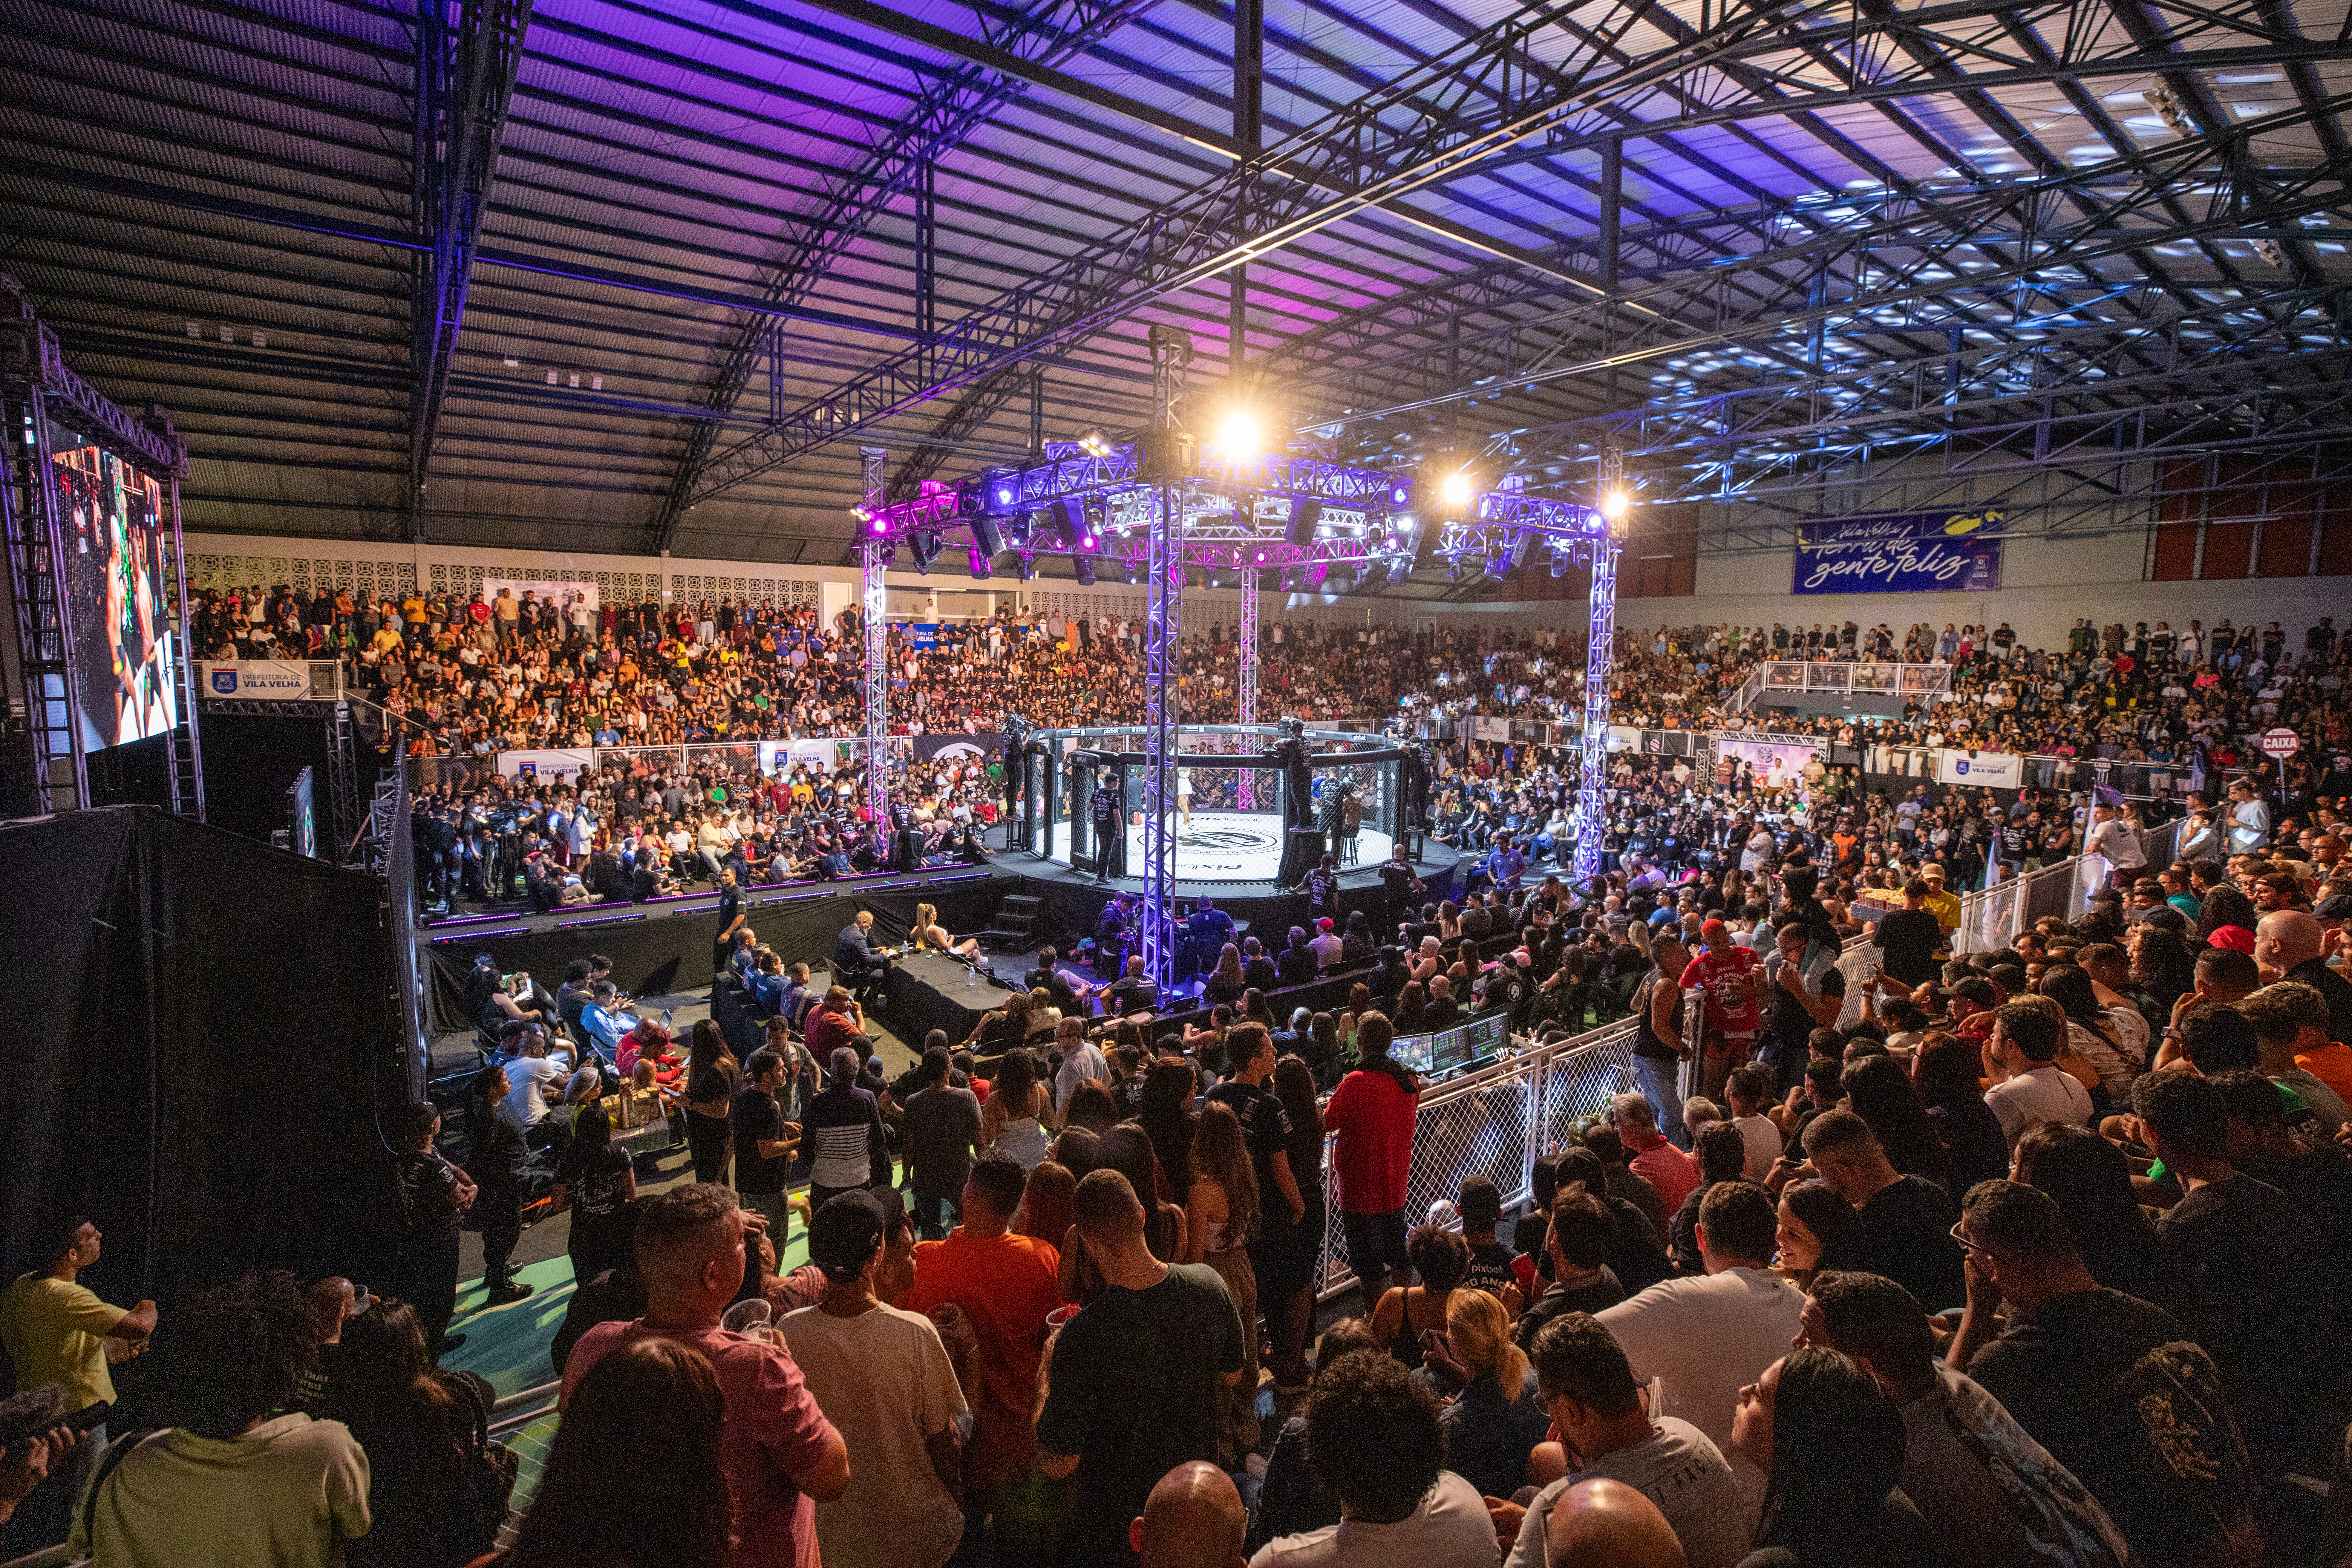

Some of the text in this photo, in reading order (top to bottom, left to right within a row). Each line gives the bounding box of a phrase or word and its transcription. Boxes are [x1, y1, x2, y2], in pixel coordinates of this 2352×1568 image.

[1804, 543, 1970, 588] gente feliz
[2264, 738, 2297, 749] CAIXA
[1472, 1263, 1503, 1274] pixbet
[1481, 1277, 1505, 1288] ANO
[1673, 1442, 1715, 1491] FACTS
